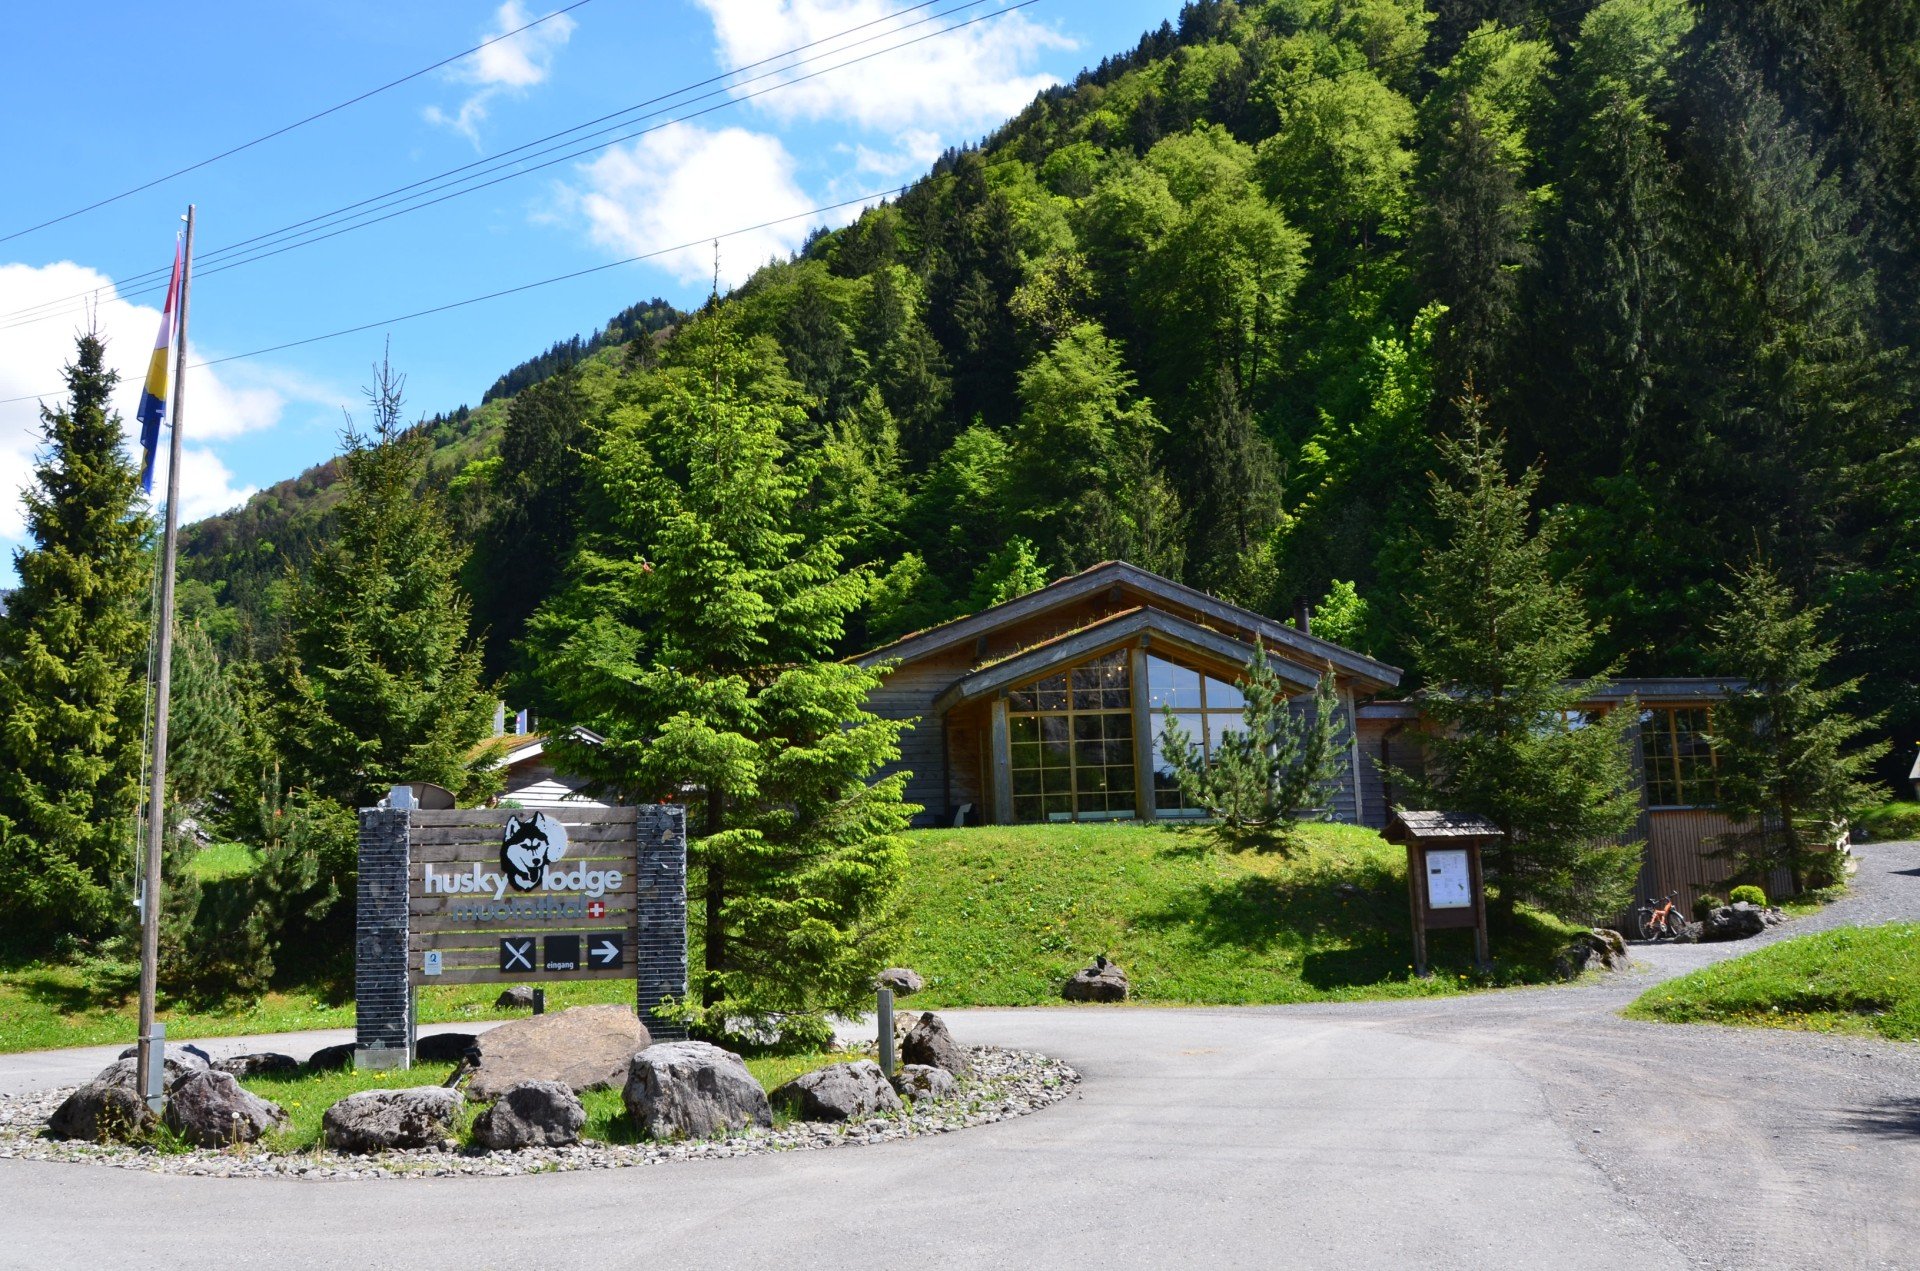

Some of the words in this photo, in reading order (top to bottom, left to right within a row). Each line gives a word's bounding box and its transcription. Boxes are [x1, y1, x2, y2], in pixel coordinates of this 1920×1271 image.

[425, 862, 508, 900] husky
[542, 861, 622, 898] lodge
[451, 893, 587, 922] muotathal
[546, 961, 574, 971] eingang
